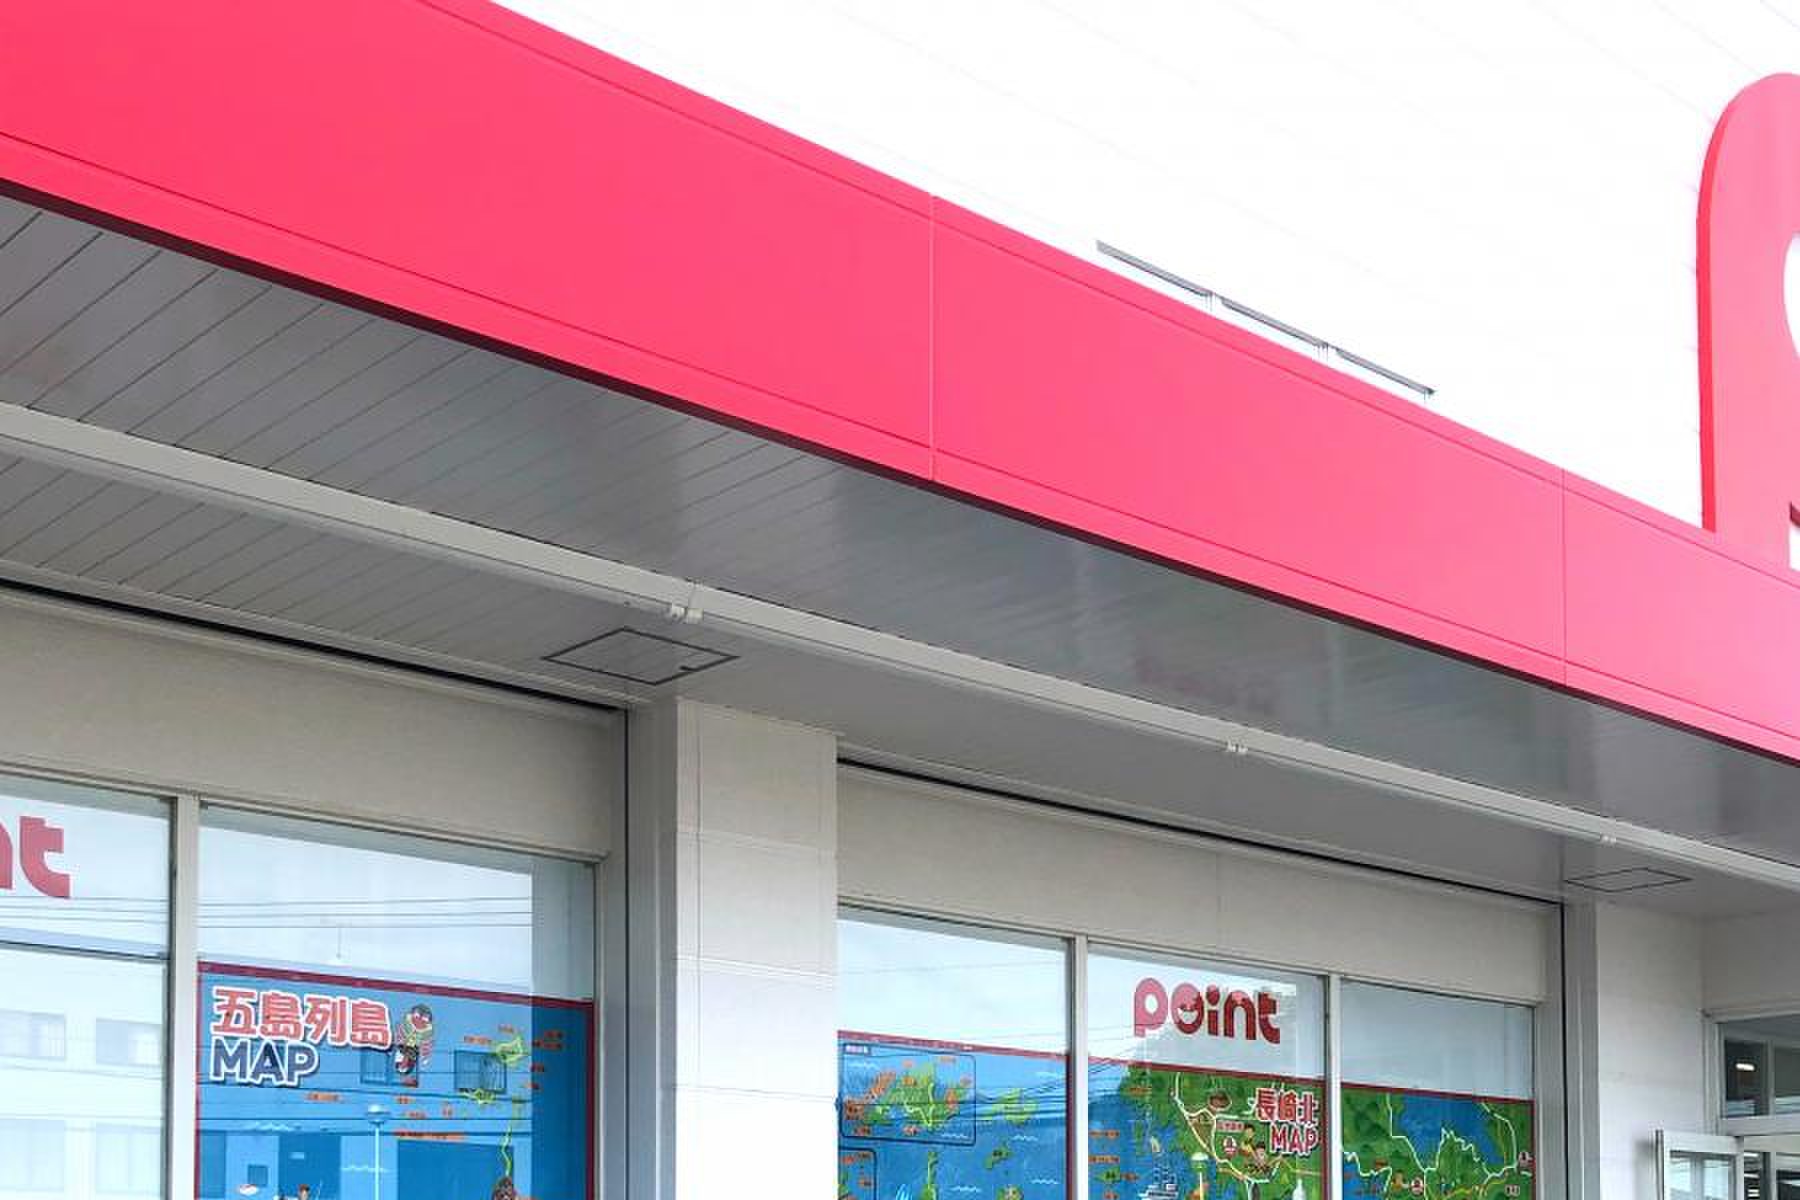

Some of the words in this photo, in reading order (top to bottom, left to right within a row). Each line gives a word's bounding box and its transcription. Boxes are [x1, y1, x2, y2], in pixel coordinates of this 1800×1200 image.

[212, 986, 391, 1049] 五島列島
[1134, 977, 1281, 1045] point
[210, 1037, 319, 1085] MAP
[1256, 1088, 1319, 1125] 長崎北
[1269, 1122, 1319, 1155] MAP
